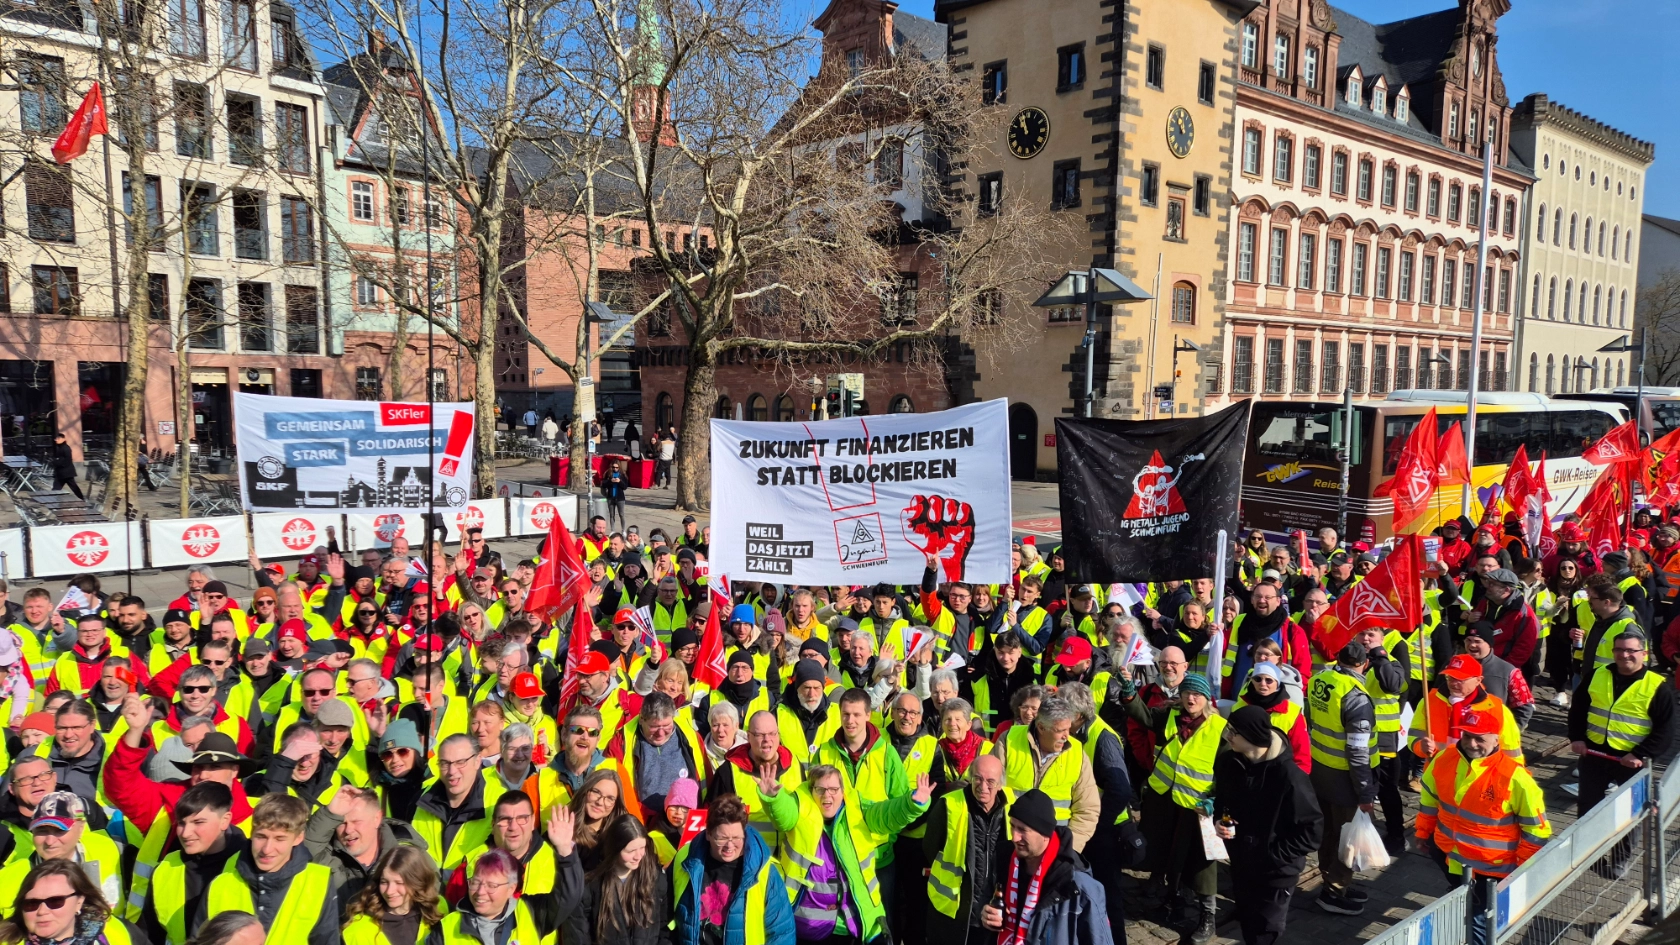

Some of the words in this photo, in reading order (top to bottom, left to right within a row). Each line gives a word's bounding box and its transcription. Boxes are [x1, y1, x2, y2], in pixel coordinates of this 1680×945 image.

[387, 409, 425, 420] SKFler
[276, 419, 366, 432] GEMEINSAM
[356, 436, 442, 451] SOLIDARISCH
[739, 438, 829, 459] ZUKUNFT
[836, 427, 974, 457] FINANZIEREN
[292, 448, 338, 461] STARK
[757, 465, 821, 486] STATT
[829, 458, 957, 484] BLOCKIEREN
[1266, 460, 1301, 483] GWK
[1553, 466, 1597, 484] GWK-Reisen
[255, 482, 289, 491] SKF
[1313, 479, 1350, 491] Reise
[1120, 519, 1129, 529] IG
[1130, 518, 1160, 529] METALL
[1161, 512, 1190, 525] JUGEND
[749, 525, 779, 538] WEIL
[1129, 523, 1182, 538] SCHWEINFURT
[748, 543, 773, 556] DAS
[775, 544, 810, 557] JETZT
[748, 557, 789, 573] ZÄHLT.
[842, 560, 888, 571] SCHWEINFURT
[1311, 678, 1335, 702] SOS
